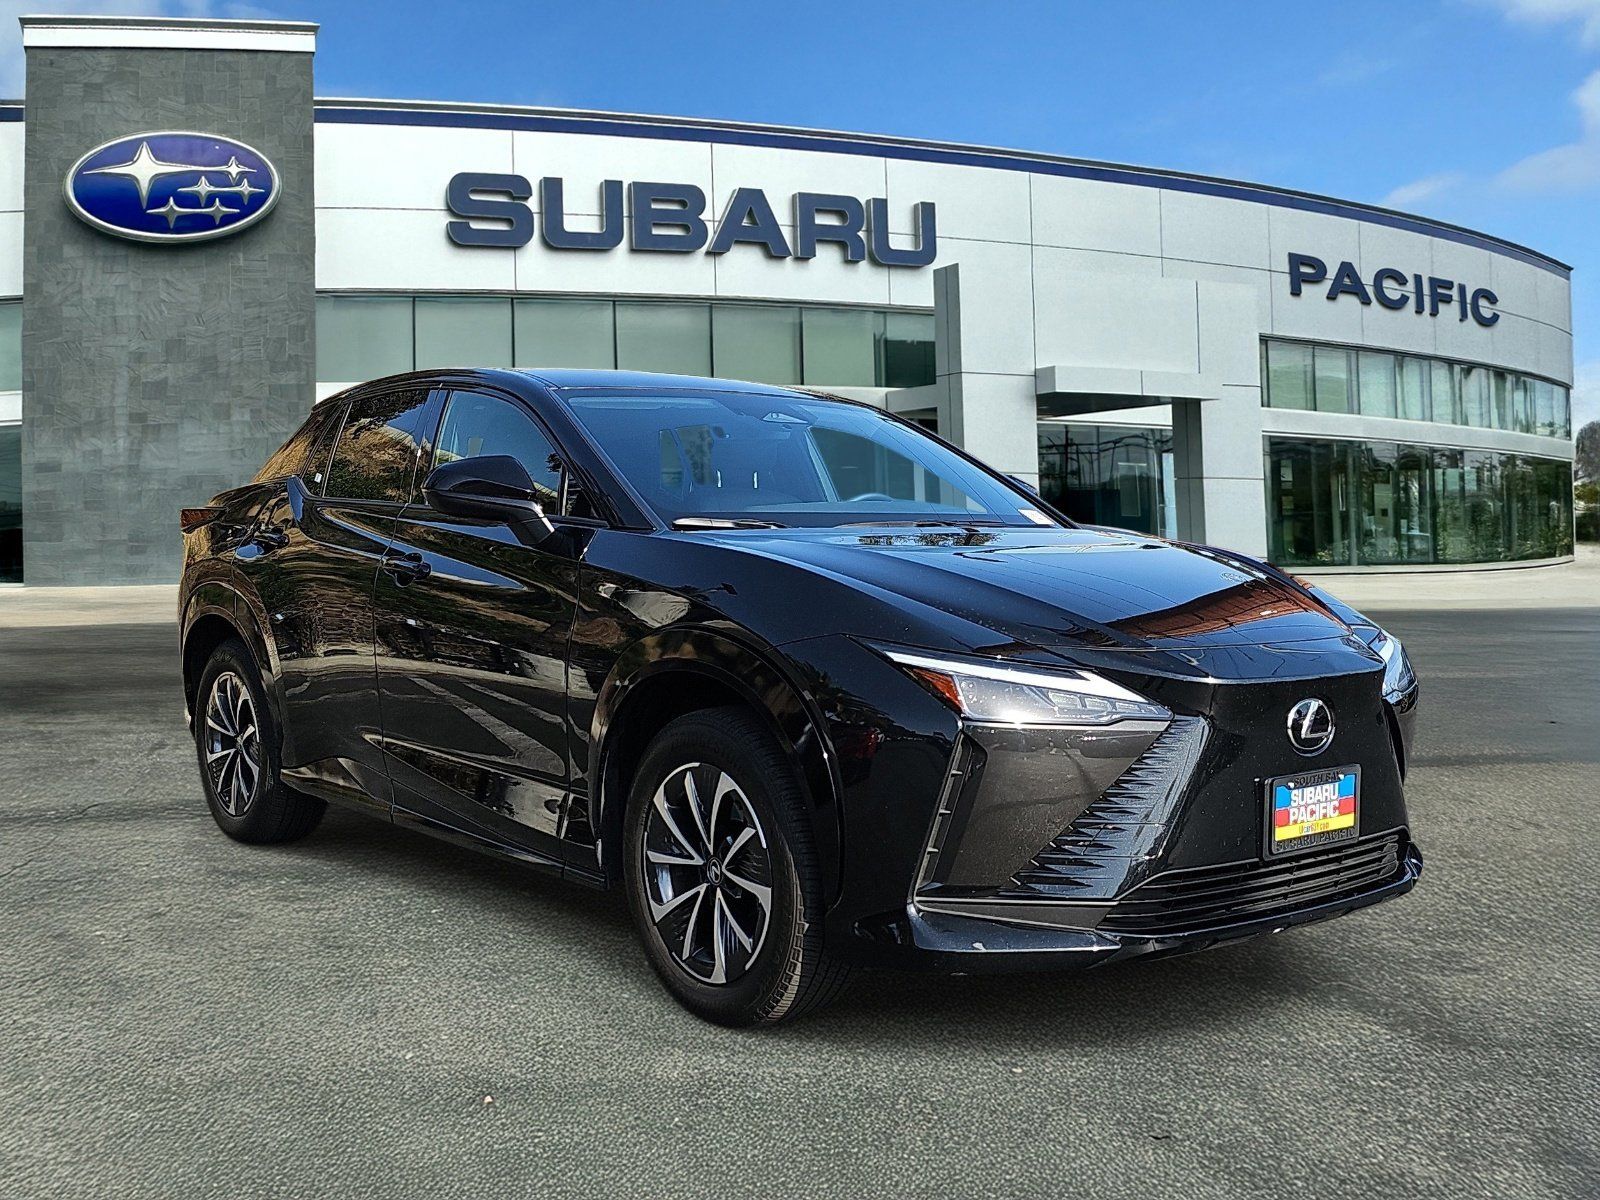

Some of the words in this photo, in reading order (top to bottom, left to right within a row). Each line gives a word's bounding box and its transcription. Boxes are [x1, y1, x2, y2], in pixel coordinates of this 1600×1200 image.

[446, 172, 936, 267] SUBARU
[1288, 252, 1500, 327] PACIFIC
[1294, 773, 1323, 787] SOUTH
[1290, 783, 1340, 807] SUBARU
[1289, 800, 1340, 826] PACIFIC
[1275, 835, 1317, 852] SUBARU
[1319, 828, 1356, 845] PACIFIC
